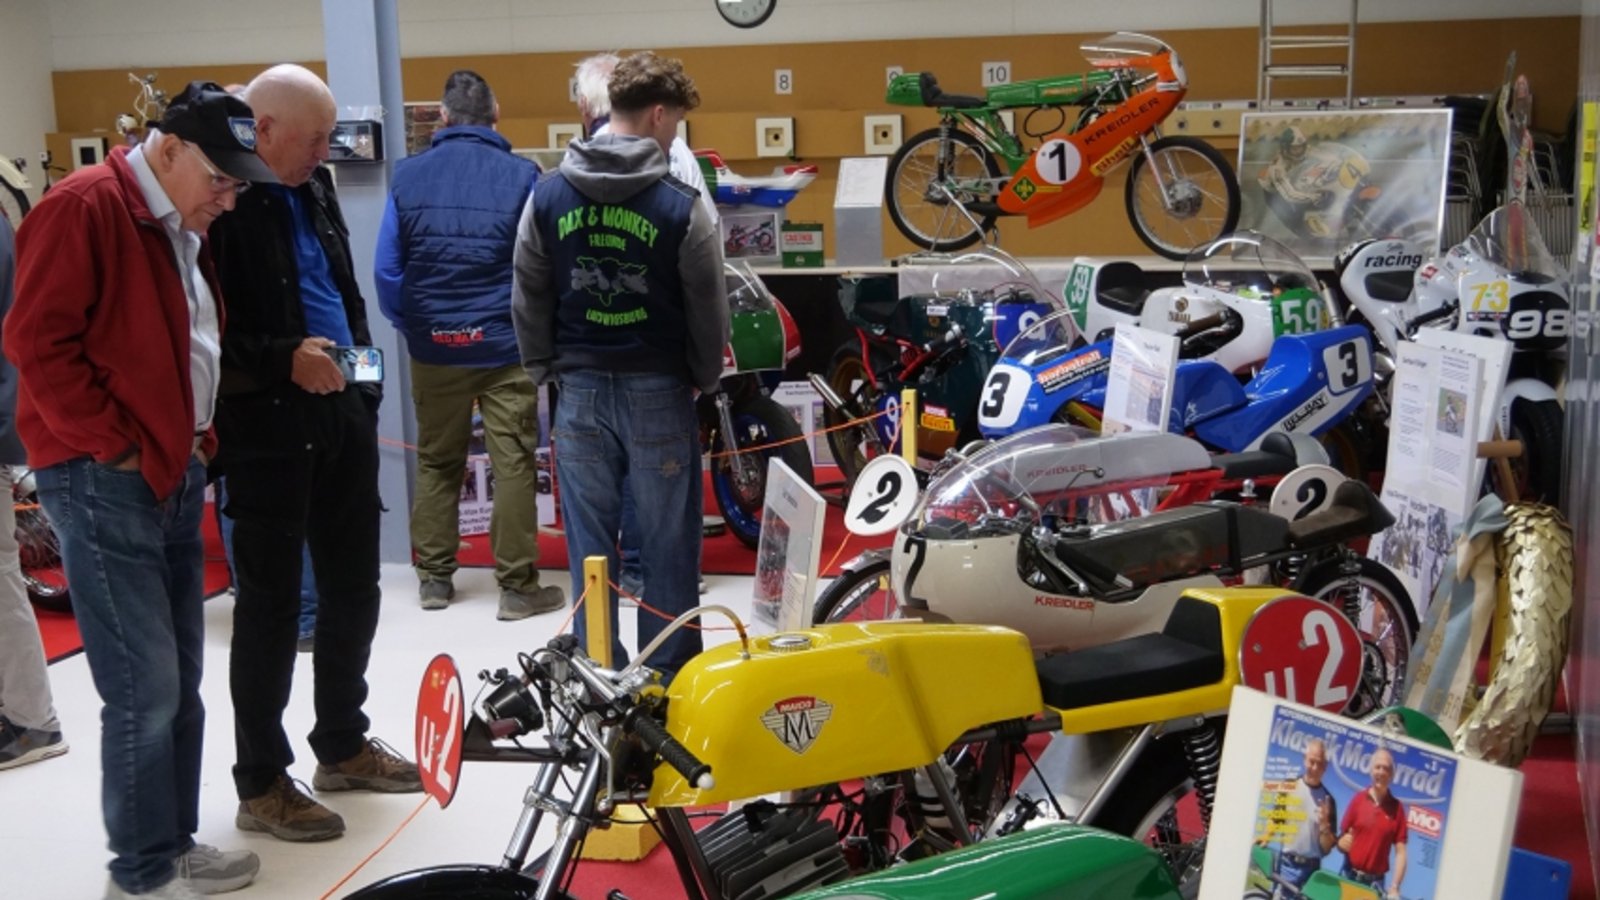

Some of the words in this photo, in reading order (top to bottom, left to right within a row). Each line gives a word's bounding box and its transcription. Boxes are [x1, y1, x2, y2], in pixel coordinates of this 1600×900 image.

[779, 74, 790, 91] 8
[988, 66, 1007, 82] 10
[1084, 98, 1160, 145] KREIDLER
[1048, 142, 1067, 181] 1
[558, 206, 584, 240] DAX
[587, 205, 598, 226] &
[602, 205, 659, 248] MONKEY
[1364, 252, 1422, 269] racing
[1281, 298, 1321, 335] 59
[1470, 280, 1510, 312] 73
[1507, 308, 1572, 340] 98
[1338, 341, 1359, 388] 3
[981, 372, 1011, 418] 3
[856, 471, 902, 524] 2
[1293, 477, 1328, 520] 2
[903, 537, 930, 611] 2
[1034, 596, 1095, 612] KREIDLER
[1302, 609, 1348, 708] 2
[436, 675, 460, 796] 2
[1339, 740, 1447, 797] Morrad
[1408, 809, 1441, 832] MO
